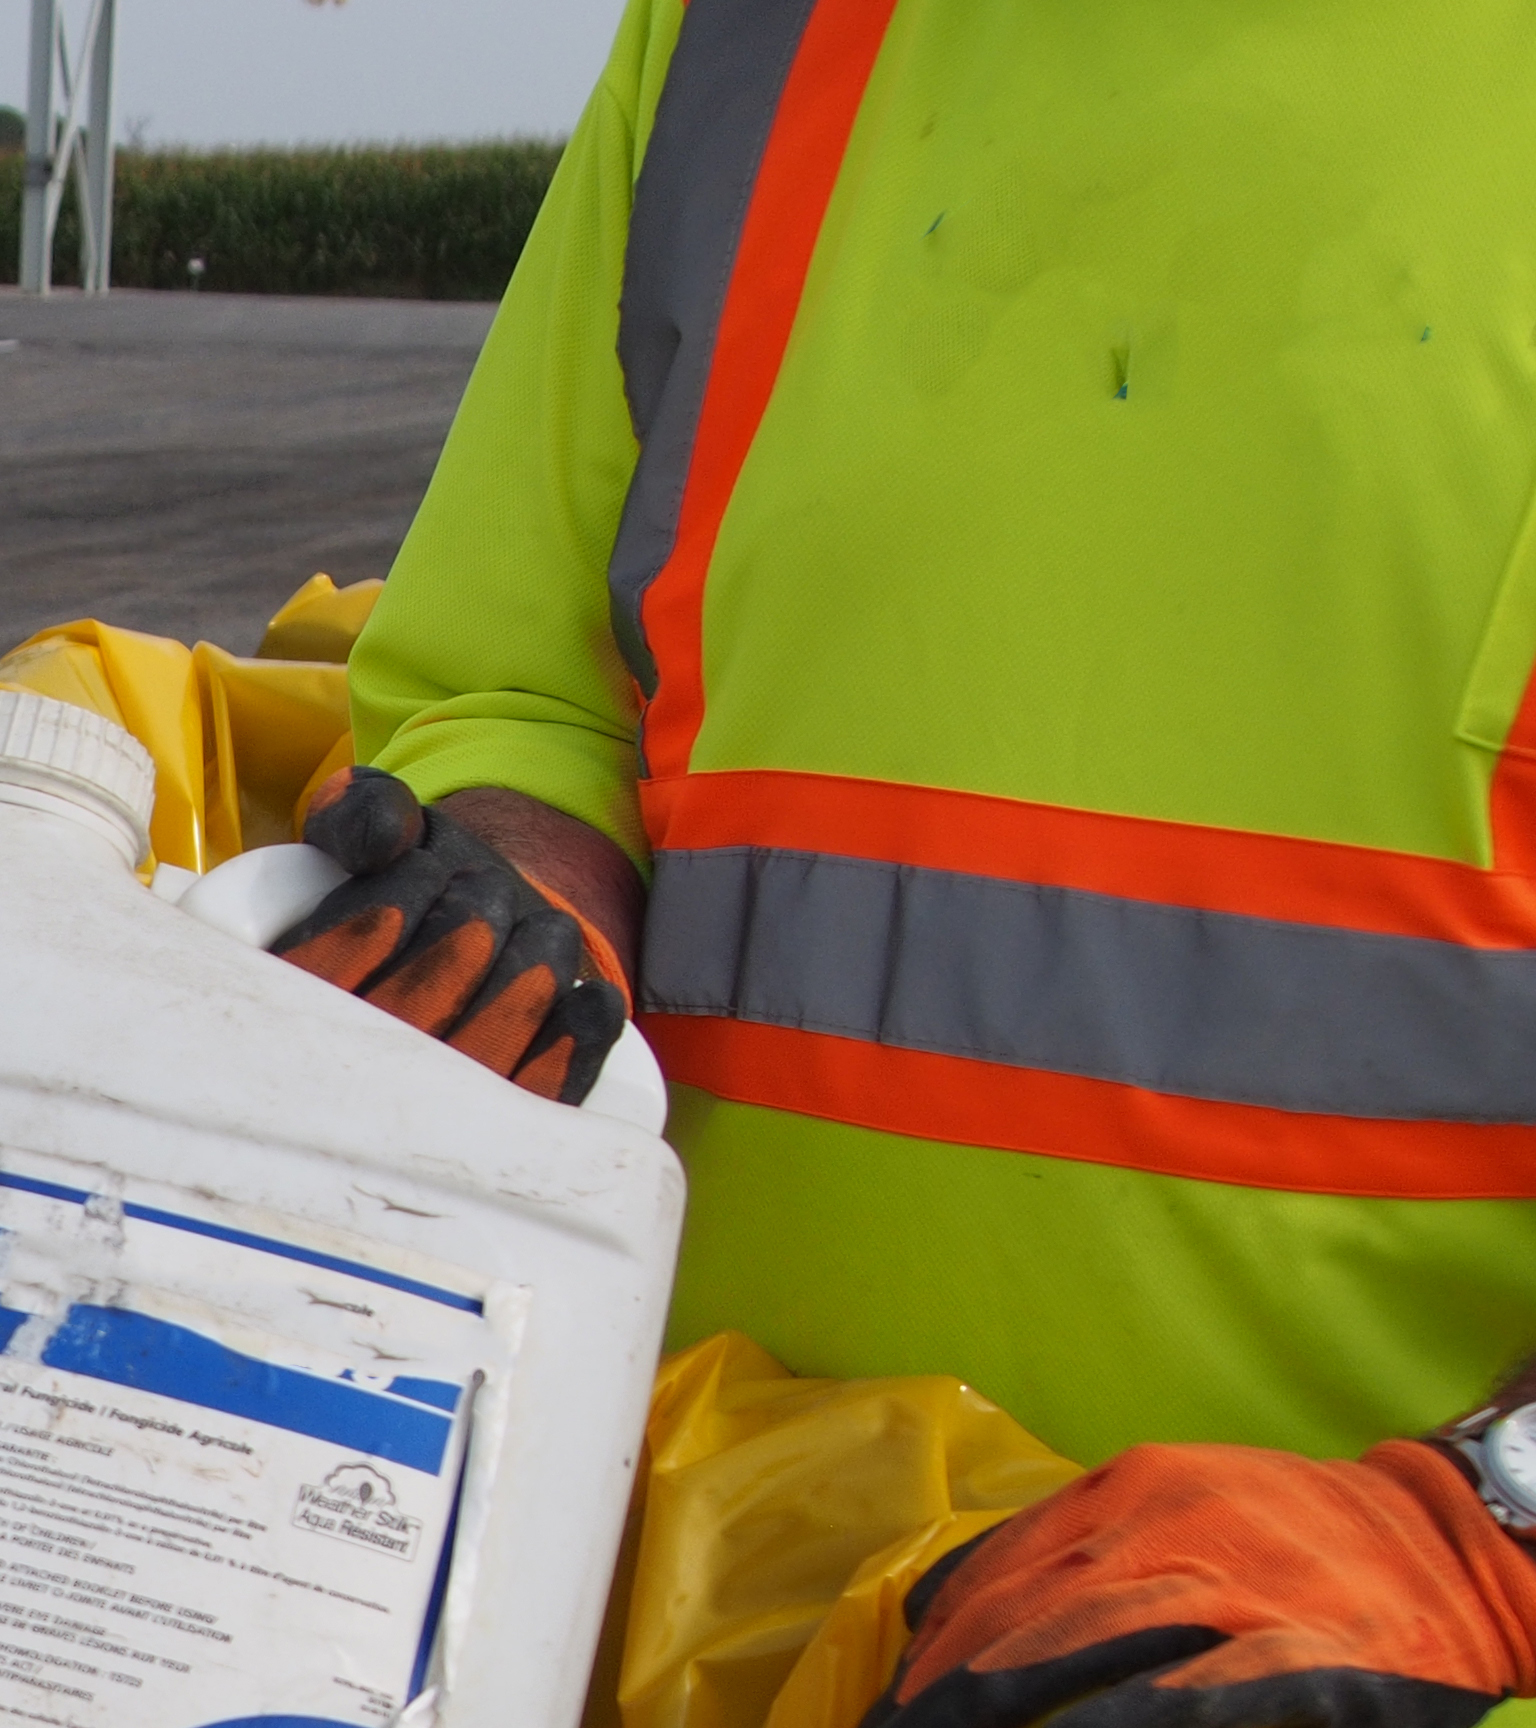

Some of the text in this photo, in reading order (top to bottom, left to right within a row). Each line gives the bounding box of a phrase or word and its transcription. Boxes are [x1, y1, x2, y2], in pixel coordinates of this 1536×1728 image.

[20, 1386, 96, 1414] Fungicide
[108, 1408, 184, 1436] Fongicide
[338, 1519, 409, 1552] Resistant
